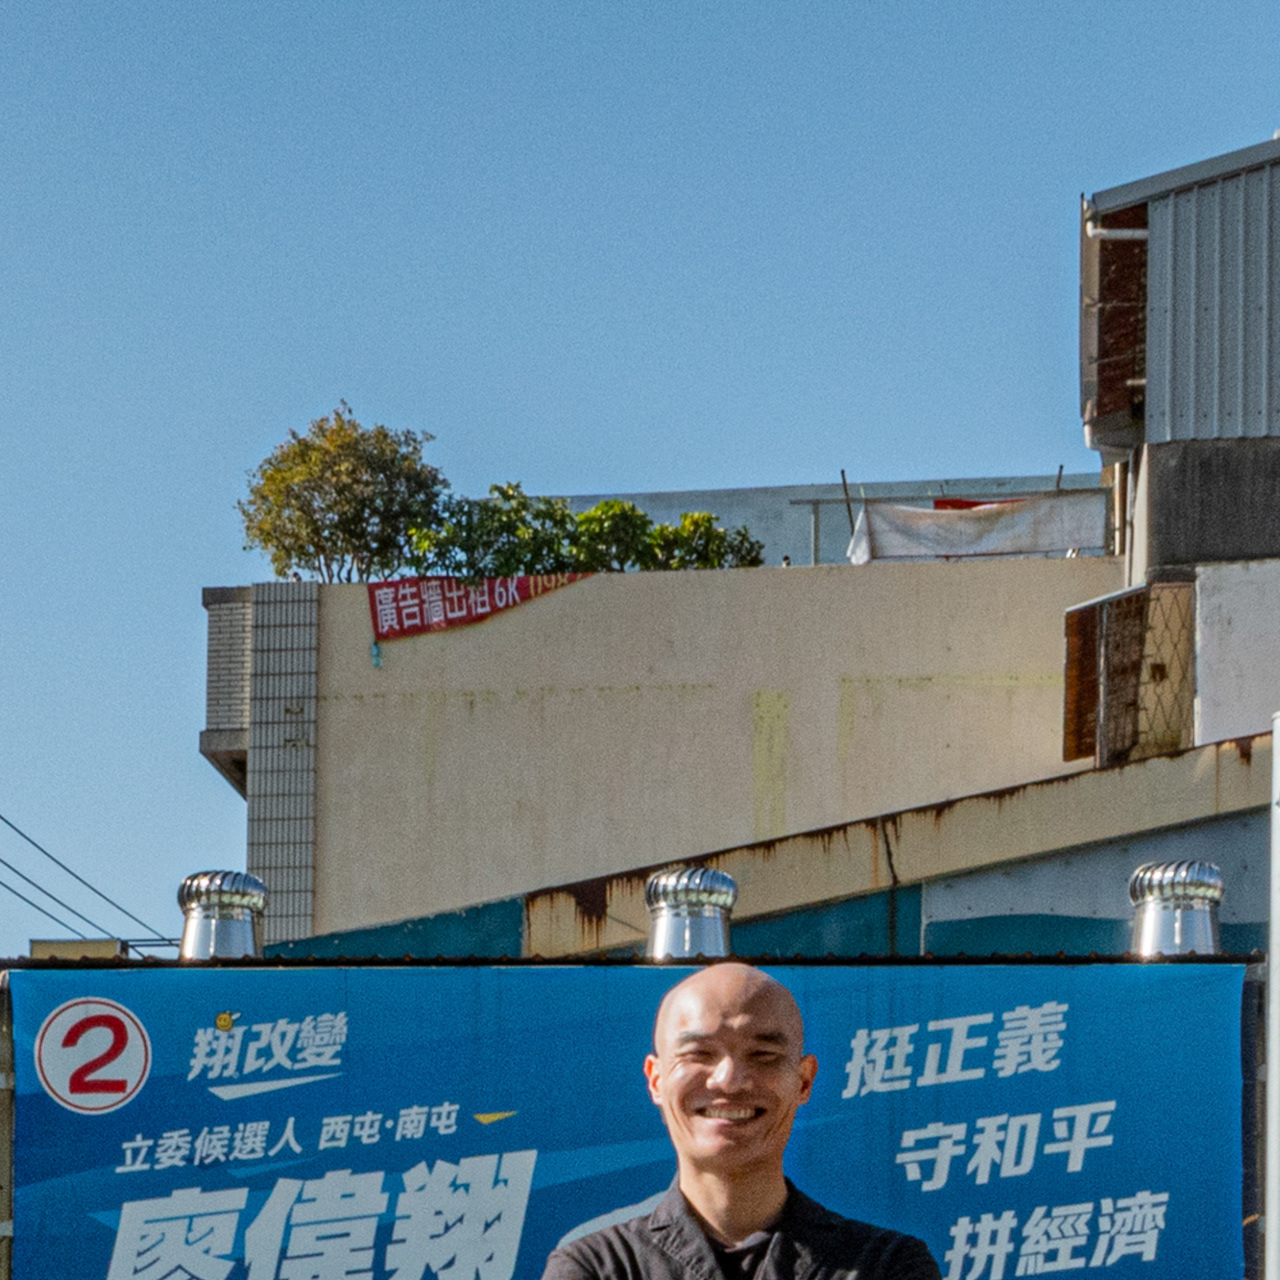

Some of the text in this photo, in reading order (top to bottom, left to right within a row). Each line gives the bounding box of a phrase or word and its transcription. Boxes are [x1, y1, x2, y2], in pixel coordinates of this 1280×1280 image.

[63, 1014, 128, 1094] 2
[840, 1000, 1070, 1100] 挺正義
[115, 1116, 303, 1174] 立委候選人
[895, 1100, 1117, 1193] 守和平
